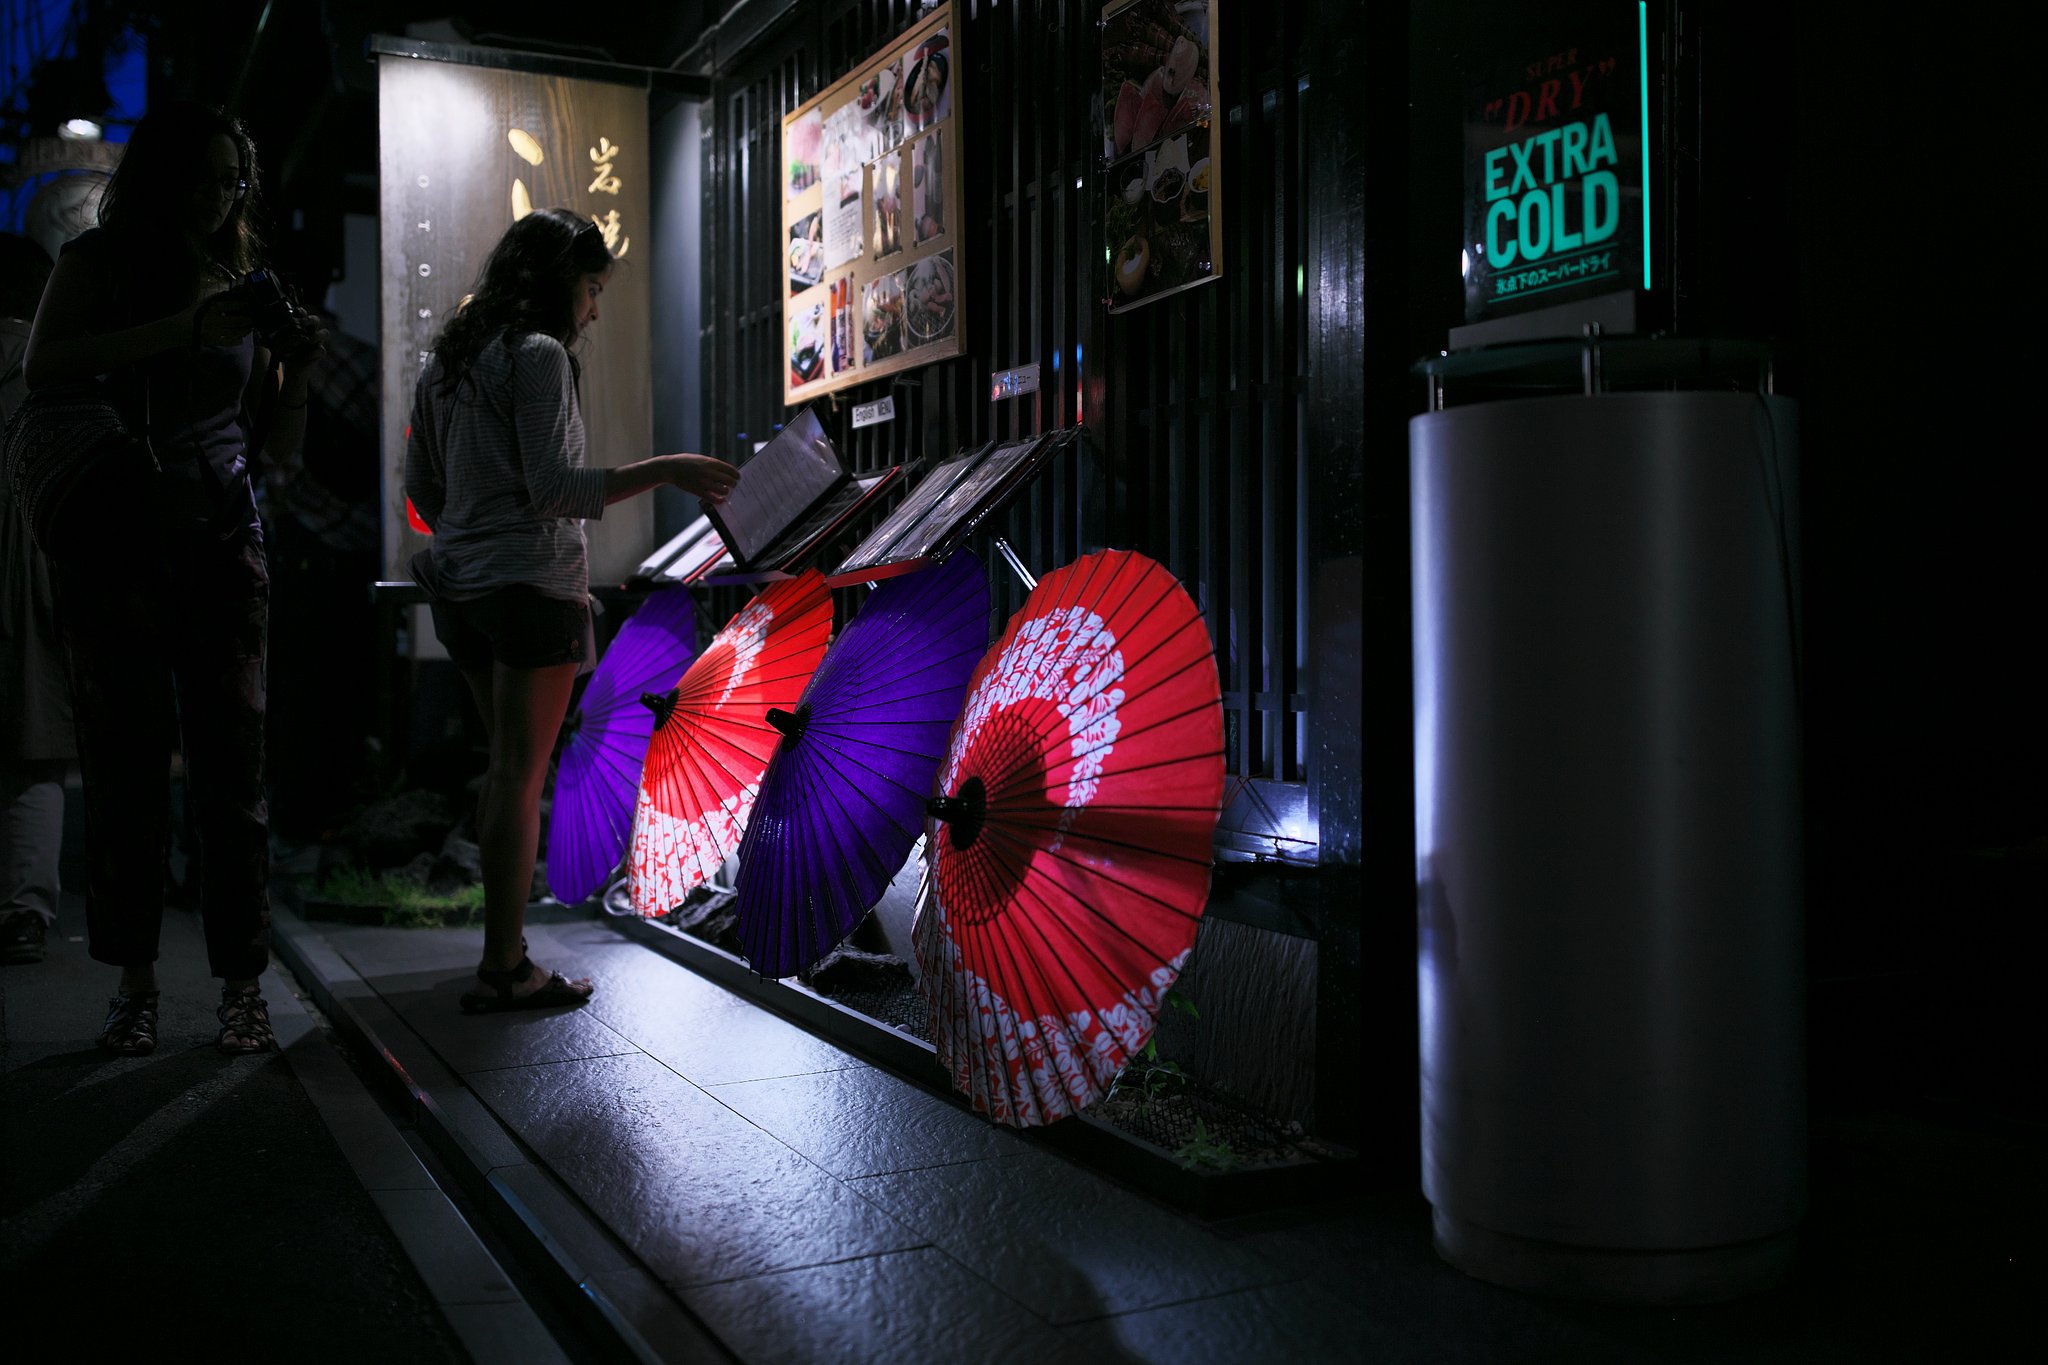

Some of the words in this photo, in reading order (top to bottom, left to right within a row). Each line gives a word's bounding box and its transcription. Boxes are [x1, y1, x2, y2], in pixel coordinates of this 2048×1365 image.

[1527, 48, 1578, 80] SUPER
[1484, 112, 1618, 202] EXTRA
[1485, 169, 1620, 269] COLD
[1495, 252, 1611, 295] 氷点下のスーパードライ
